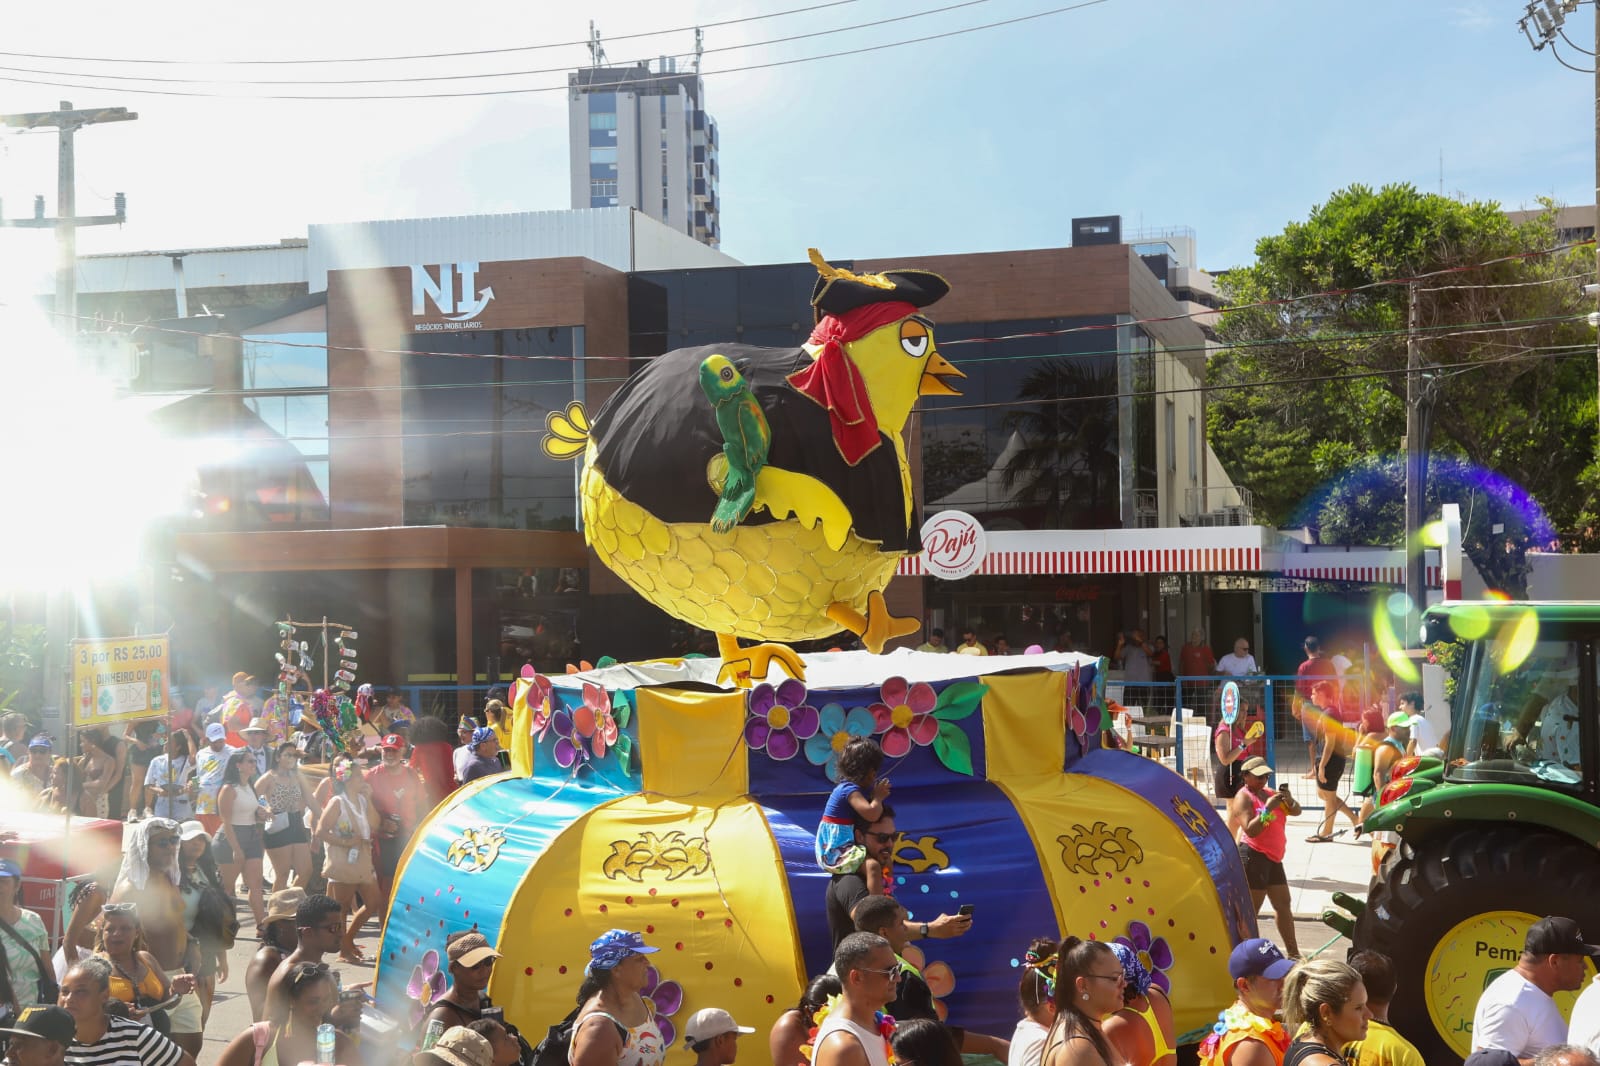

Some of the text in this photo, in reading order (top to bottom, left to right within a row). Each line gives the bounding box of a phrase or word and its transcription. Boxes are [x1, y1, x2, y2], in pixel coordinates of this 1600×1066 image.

[409, 262, 480, 315] NI
[415, 320, 482, 331] NEGÓCIOS IMOBILIÁRIOS
[921, 522, 977, 562] Pajú
[80, 649, 88, 664] 3
[92, 652, 110, 667] por
[132, 645, 162, 660] 25,00
[96, 670, 148, 685] DINHEIRO OU
